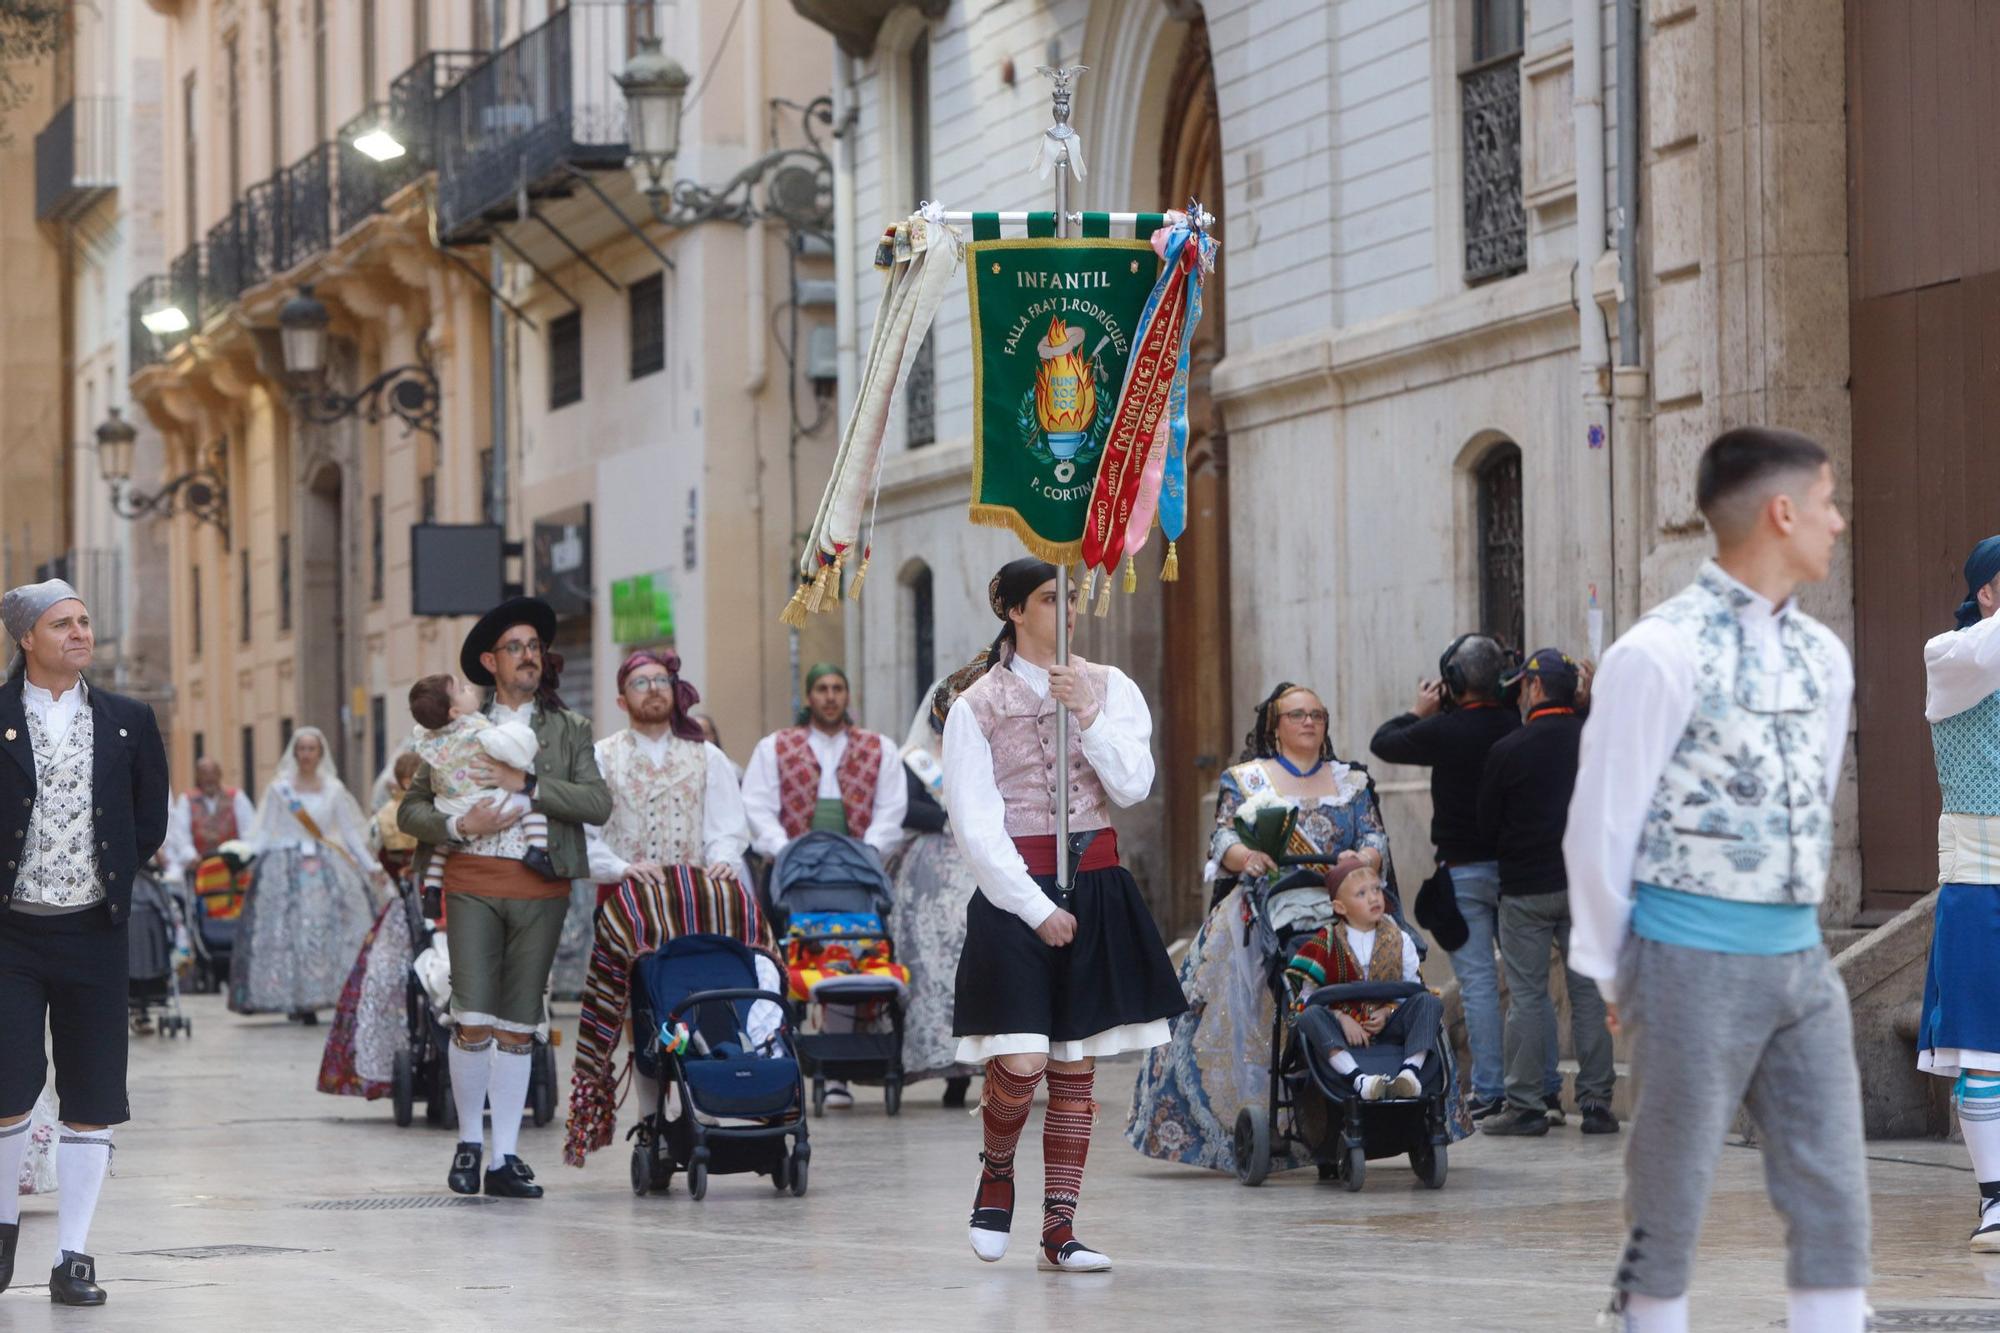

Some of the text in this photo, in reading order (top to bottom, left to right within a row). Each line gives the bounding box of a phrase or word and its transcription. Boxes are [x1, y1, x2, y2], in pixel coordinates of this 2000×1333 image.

[1016, 271, 1111, 289] INFANTIL
[1004, 315, 1030, 355] FALLA
[1028, 297, 1058, 319] FRAY
[1054, 399, 1076, 410] FOC
